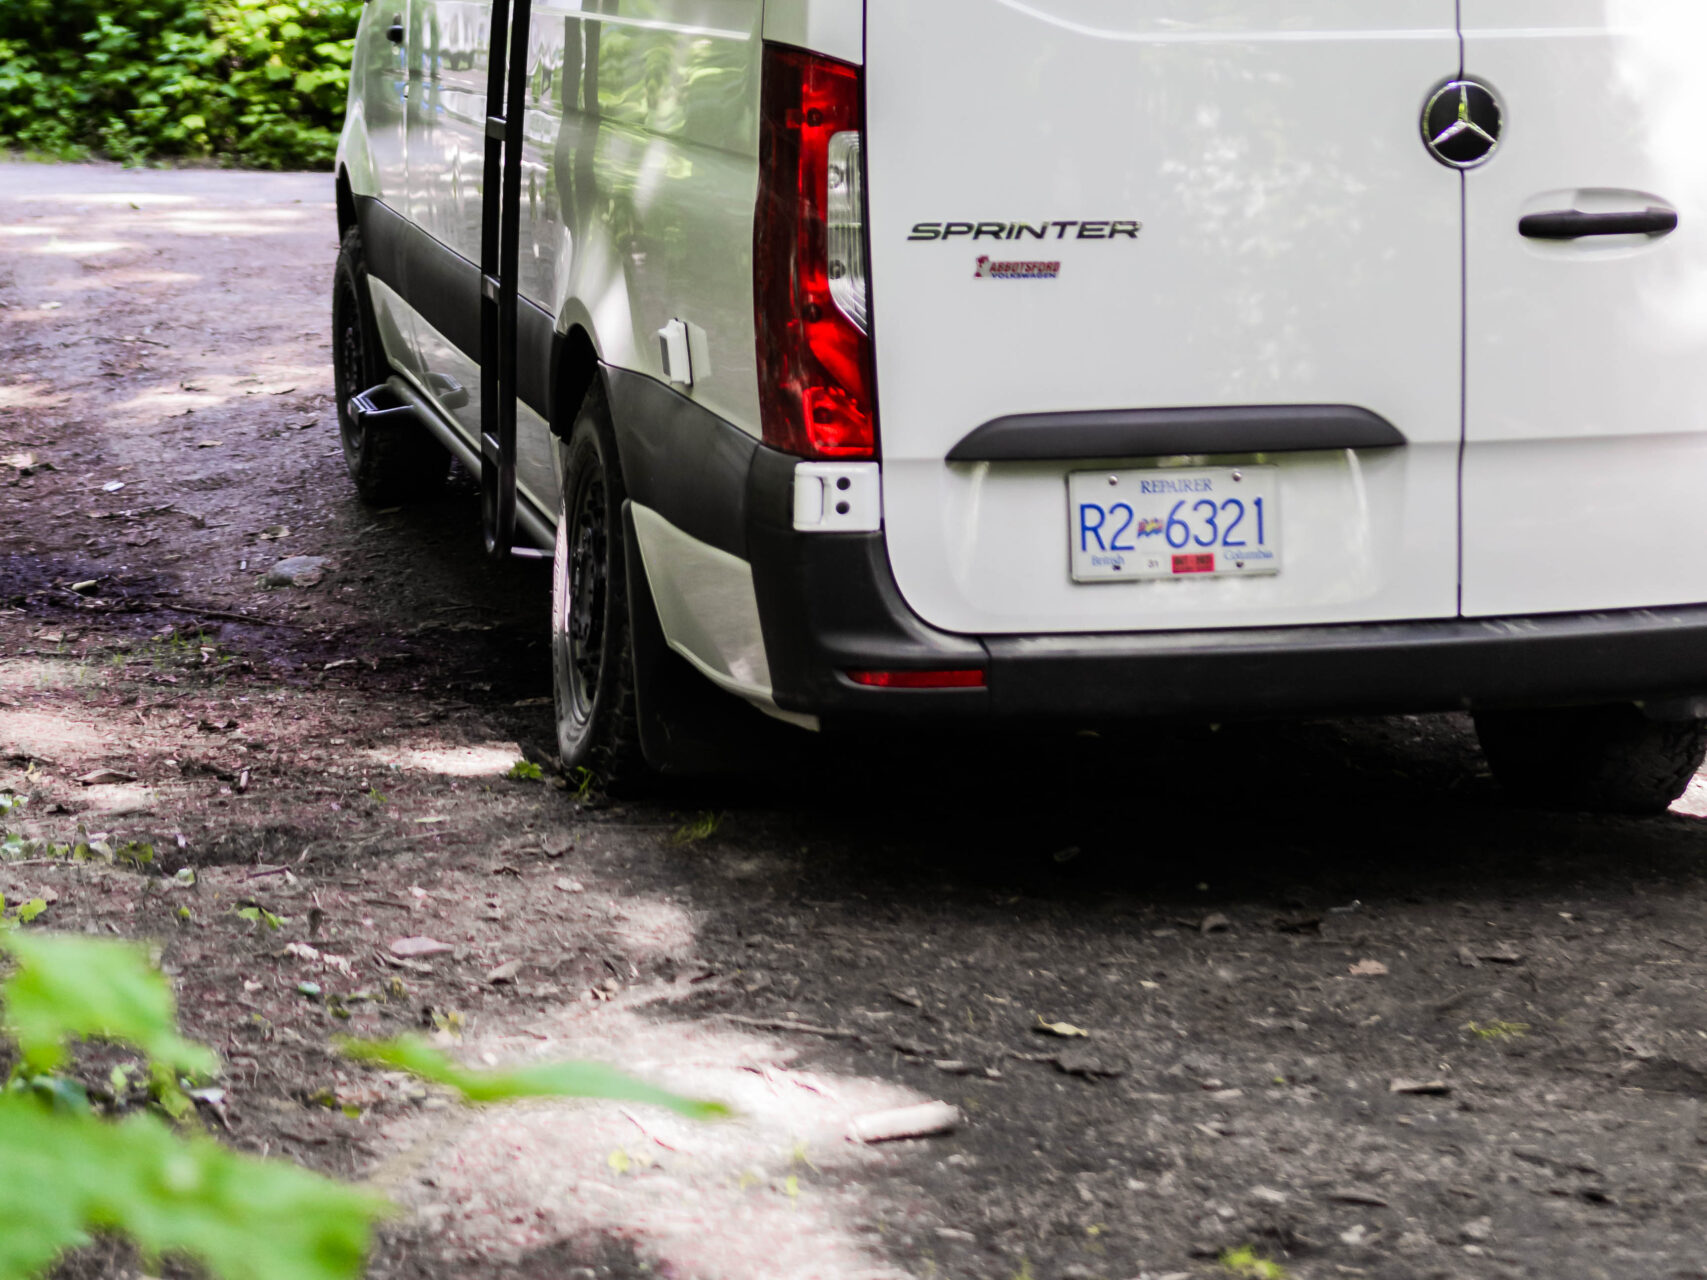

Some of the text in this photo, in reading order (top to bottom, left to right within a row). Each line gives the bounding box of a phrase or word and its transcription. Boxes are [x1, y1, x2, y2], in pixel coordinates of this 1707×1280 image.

[907, 221, 1142, 240] SPRINTER
[989, 261, 1060, 272] ABBOTSFORD
[1140, 478, 1214, 494] REPAIRER
[1079, 496, 1264, 552] R2 6321
